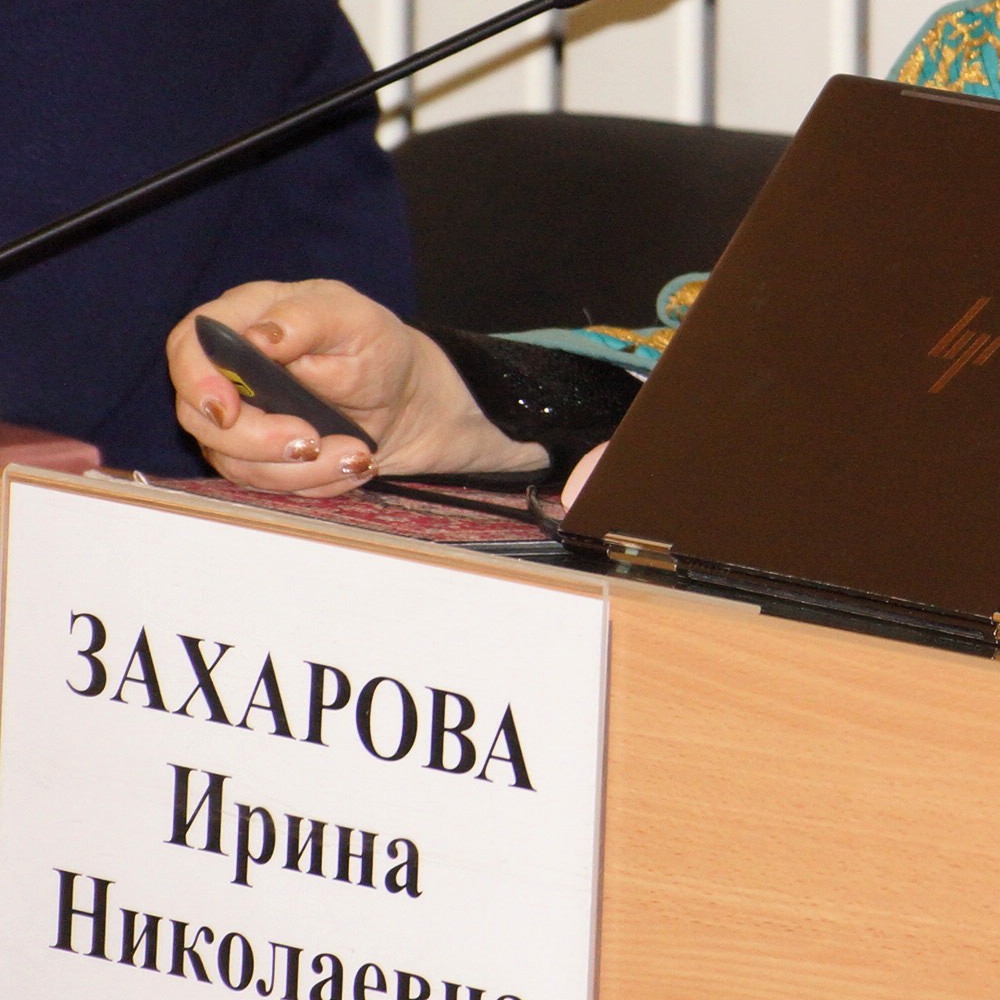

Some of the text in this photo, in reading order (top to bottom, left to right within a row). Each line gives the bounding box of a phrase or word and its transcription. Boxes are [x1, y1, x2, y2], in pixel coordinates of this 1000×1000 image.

[66, 610, 536, 792] ЗАХАРОВА
[164, 762, 423, 898] Ирина
[50, 867, 524, 1000] Николаев
